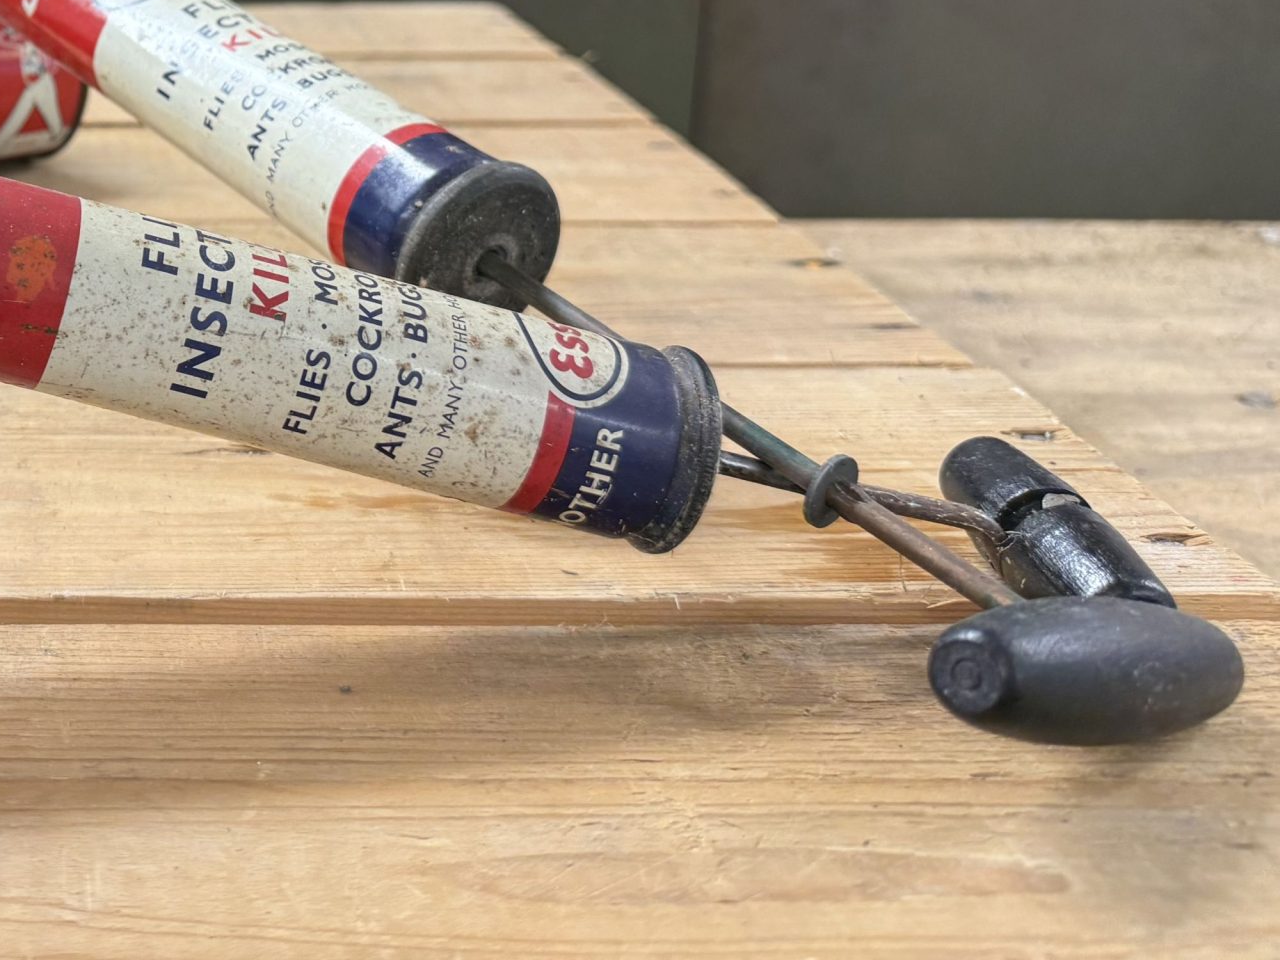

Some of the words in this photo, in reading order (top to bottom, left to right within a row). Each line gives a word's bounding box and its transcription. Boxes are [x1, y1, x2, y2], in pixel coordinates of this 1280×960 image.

[246, 98, 287, 161] ANTS
[170, 230, 236, 399] INSECT
[282, 348, 332, 435] FLIES
[374, 367, 423, 460] ANTS
[418, 446, 444, 478] AND
[437, 380, 464, 439] MANY
[452, 314, 468, 371] OTHER
